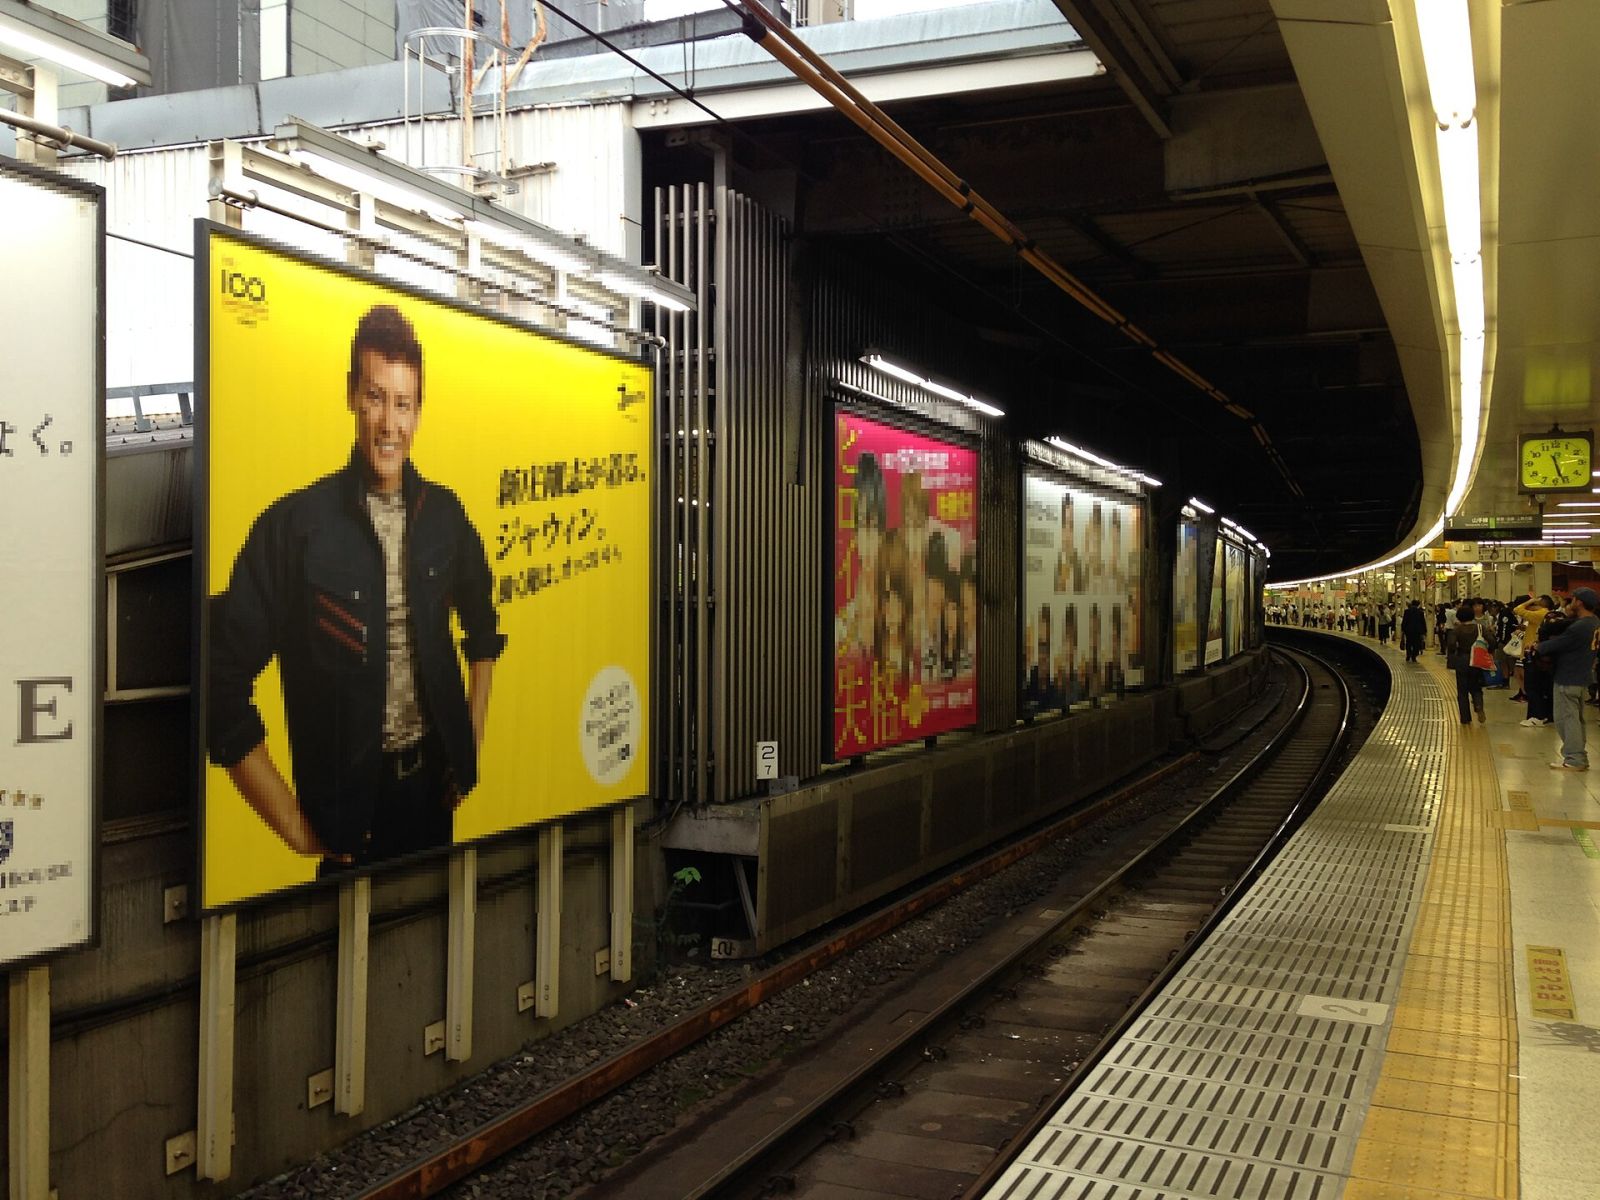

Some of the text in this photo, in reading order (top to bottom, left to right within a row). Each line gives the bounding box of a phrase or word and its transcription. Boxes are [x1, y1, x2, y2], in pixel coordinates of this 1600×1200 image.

[761, 745, 775, 760] 2
[764, 764, 772, 776] 7
[1321, 1003, 1369, 1017] 2
